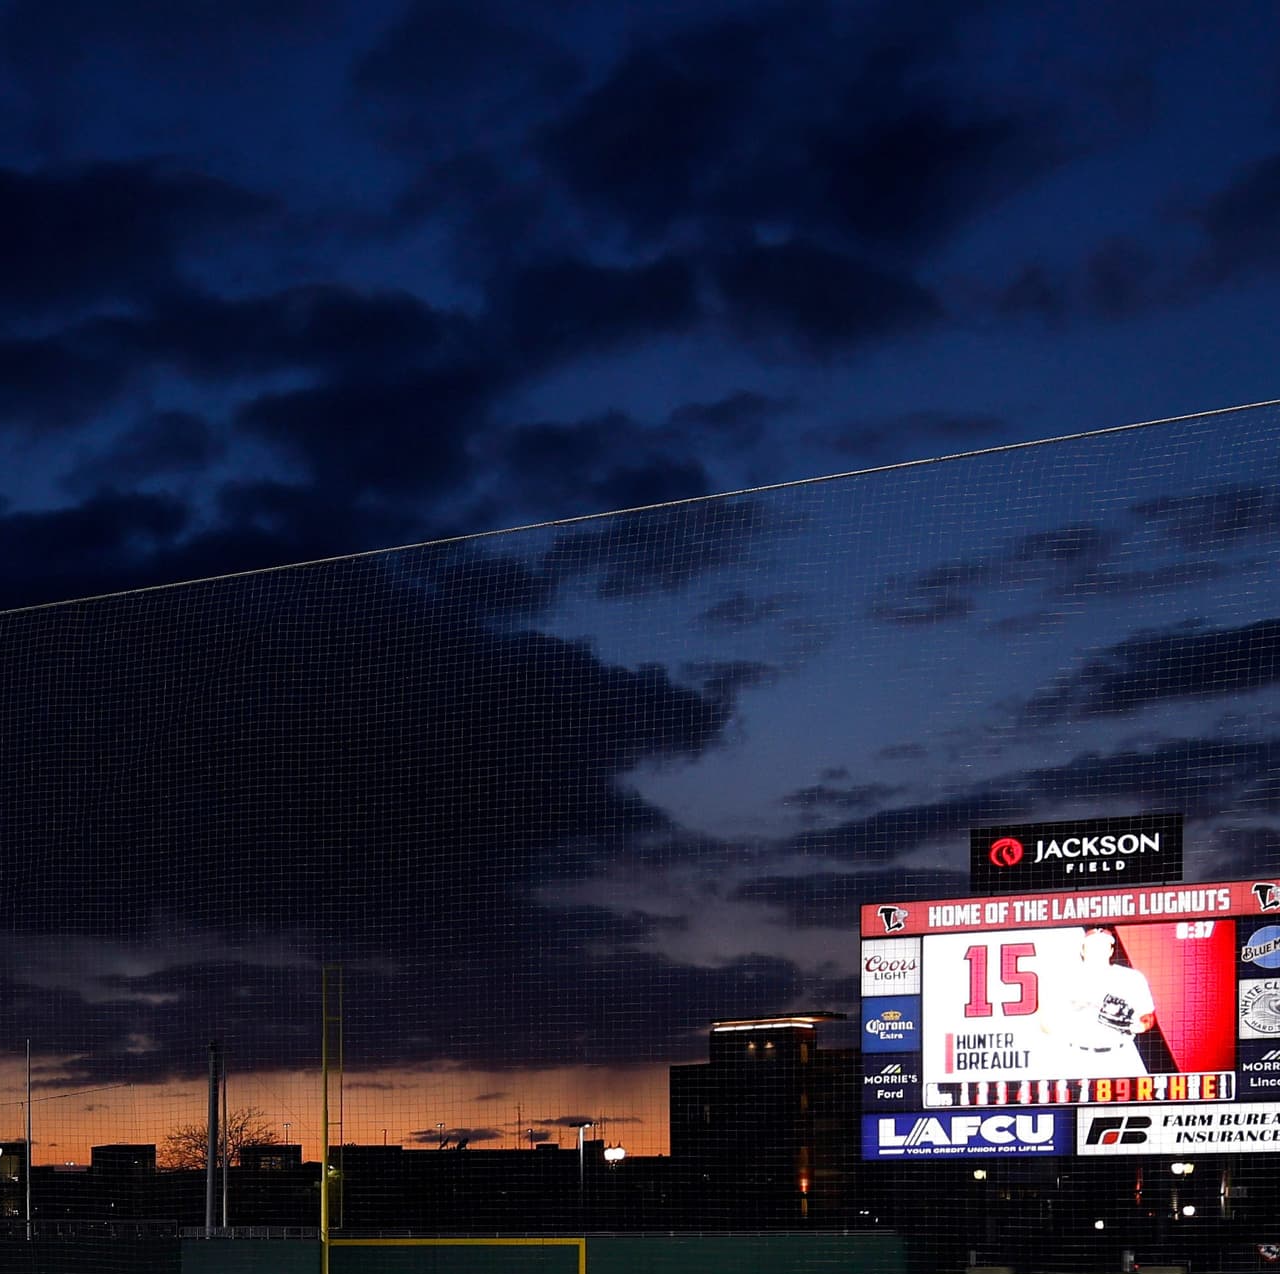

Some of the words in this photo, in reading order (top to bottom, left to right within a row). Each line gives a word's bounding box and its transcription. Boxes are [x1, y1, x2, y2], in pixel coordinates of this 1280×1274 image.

[1035, 833, 1159, 863] JACKSON
[1066, 860, 1126, 874] FIELD
[928, 904, 981, 927] HOME
[985, 901, 1009, 923] OF
[1013, 899, 1047, 922] THE
[1052, 895, 1135, 920] LANSING
[1140, 888, 1230, 915] LUGNUTS
[1242, 943, 1272, 960] BLUE
[865, 955, 918, 972] Coors
[874, 971, 907, 980] LIGHT
[964, 943, 1039, 1018] 15
[1241, 985, 1262, 1016] WHITE
[866, 1019, 914, 1034] Corona
[1251, 1020, 1273, 1031] HARD
[956, 1032, 1014, 1050] HUNTER
[956, 1050, 1030, 1070] BREAULT
[864, 1075, 917, 1084] MORRIE'S
[877, 1090, 903, 1099] Ford
[1163, 1114, 1213, 1127] FARM
[879, 1114, 1054, 1146] LAFCU
